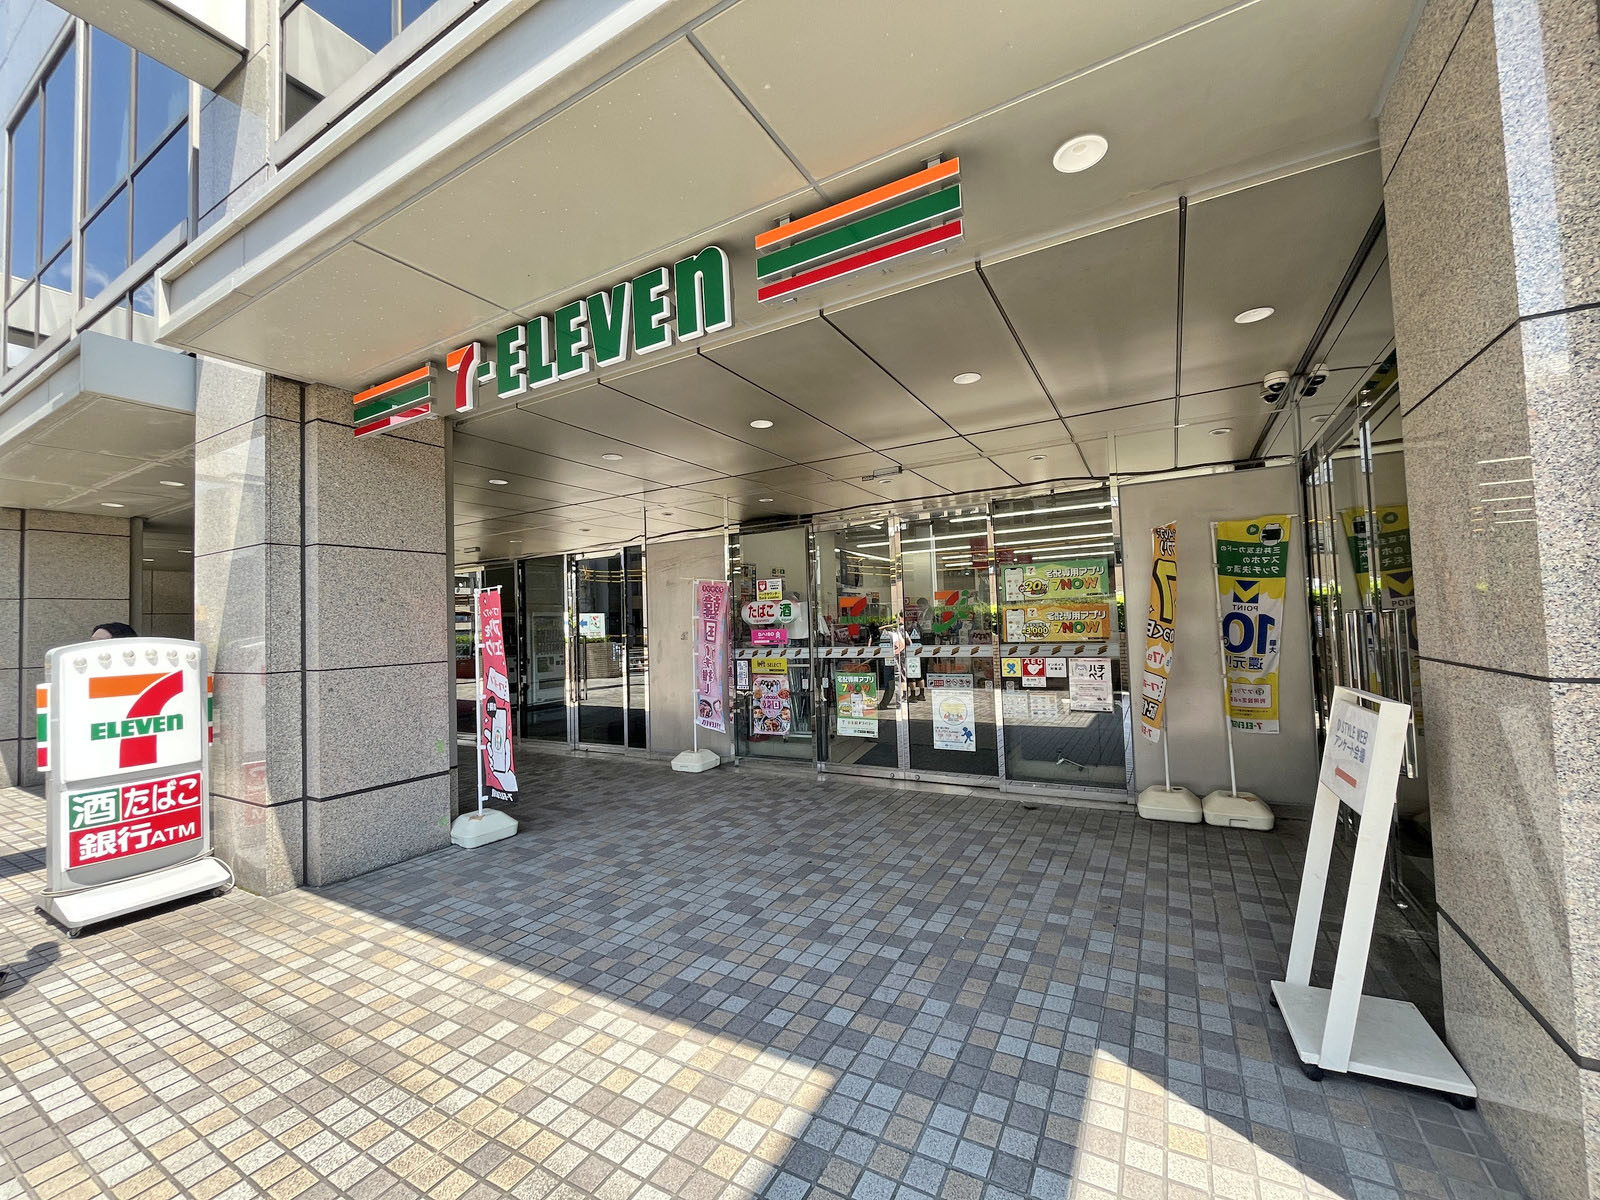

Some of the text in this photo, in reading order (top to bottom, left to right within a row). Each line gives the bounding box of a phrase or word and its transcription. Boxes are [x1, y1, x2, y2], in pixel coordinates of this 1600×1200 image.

[1051, 577, 1098, 591] 7NOW
[748, 603, 792, 619] たばこ 酒
[1053, 621, 1101, 634] 7NOW
[72, 791, 117, 828] 酒
[124, 778, 199, 818] たばこ
[79, 822, 195, 861] 銀行ATM
